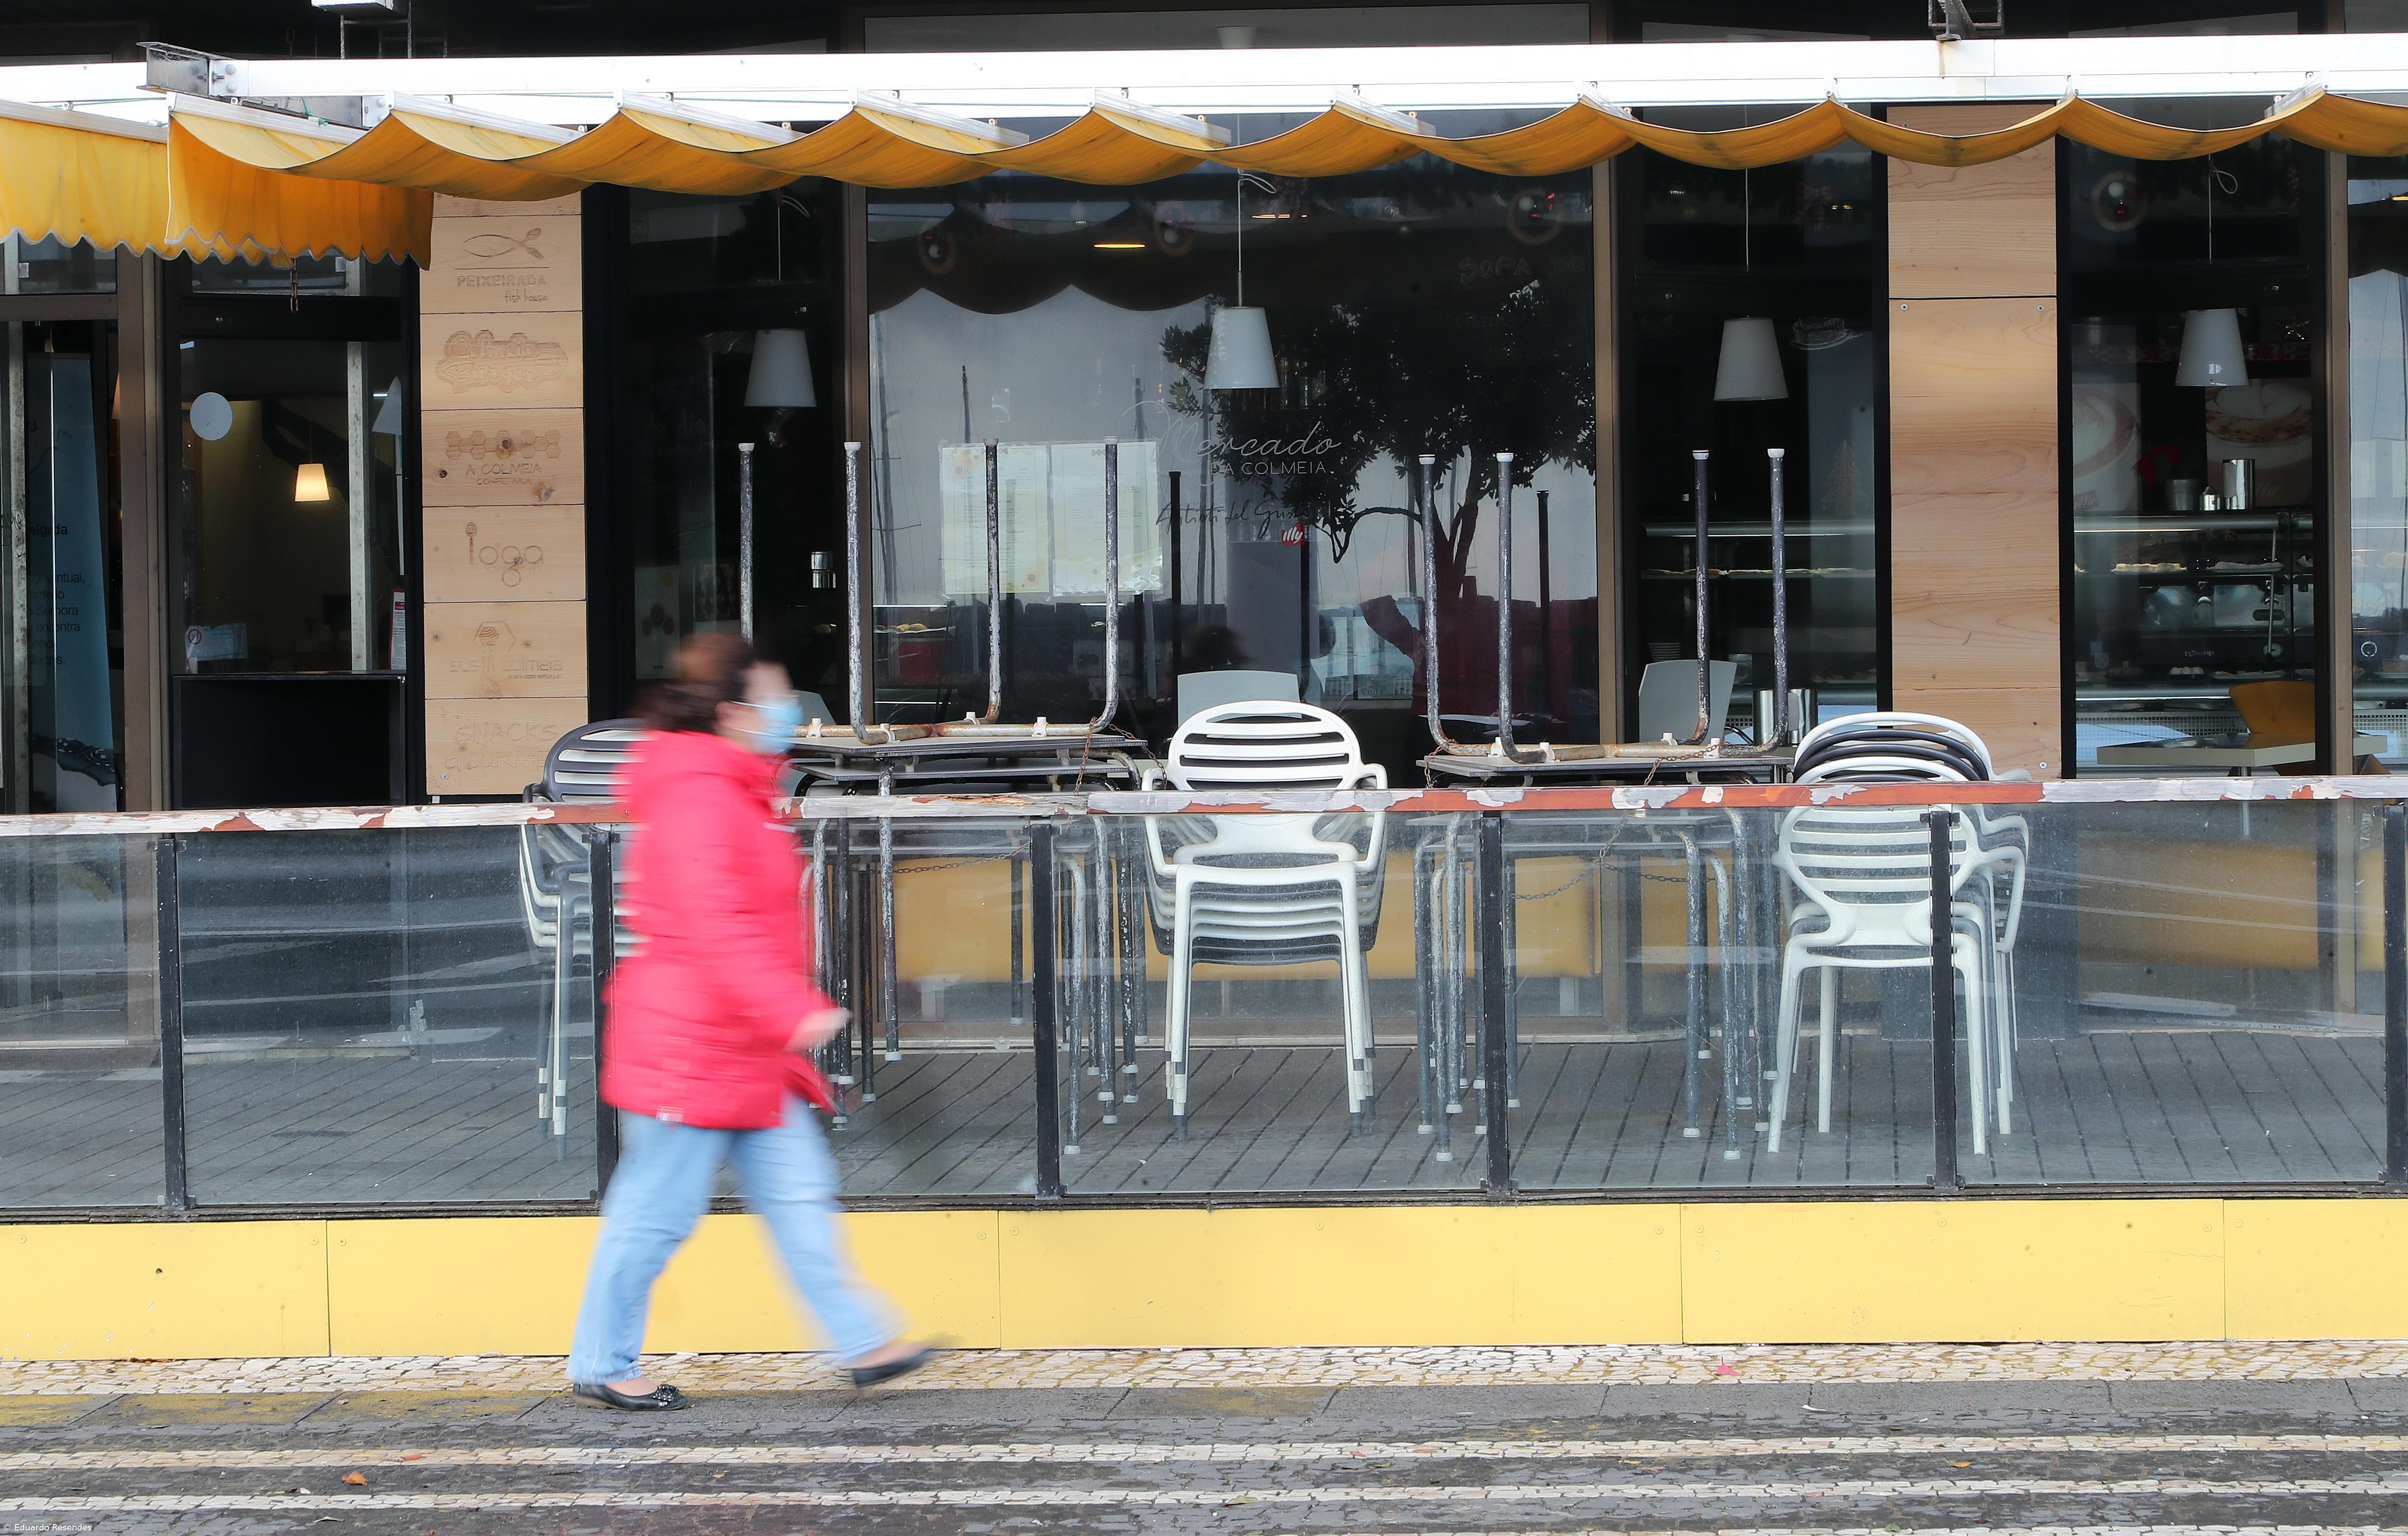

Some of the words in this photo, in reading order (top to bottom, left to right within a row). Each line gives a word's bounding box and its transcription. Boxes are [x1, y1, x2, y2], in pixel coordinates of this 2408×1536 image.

[457, 275, 547, 287] PEIXEIRADA
[504, 289, 521, 303] fish
[524, 289, 548, 302] house
[1121, 401, 1342, 464] Mercado
[466, 464, 476, 476] A
[482, 463, 542, 475] COLMEIA
[1211, 462, 1234, 475] DA
[1241, 461, 1326, 475] COLMEIA
[1282, 526, 1303, 543] illy
[455, 722, 558, 742] SNACKS
